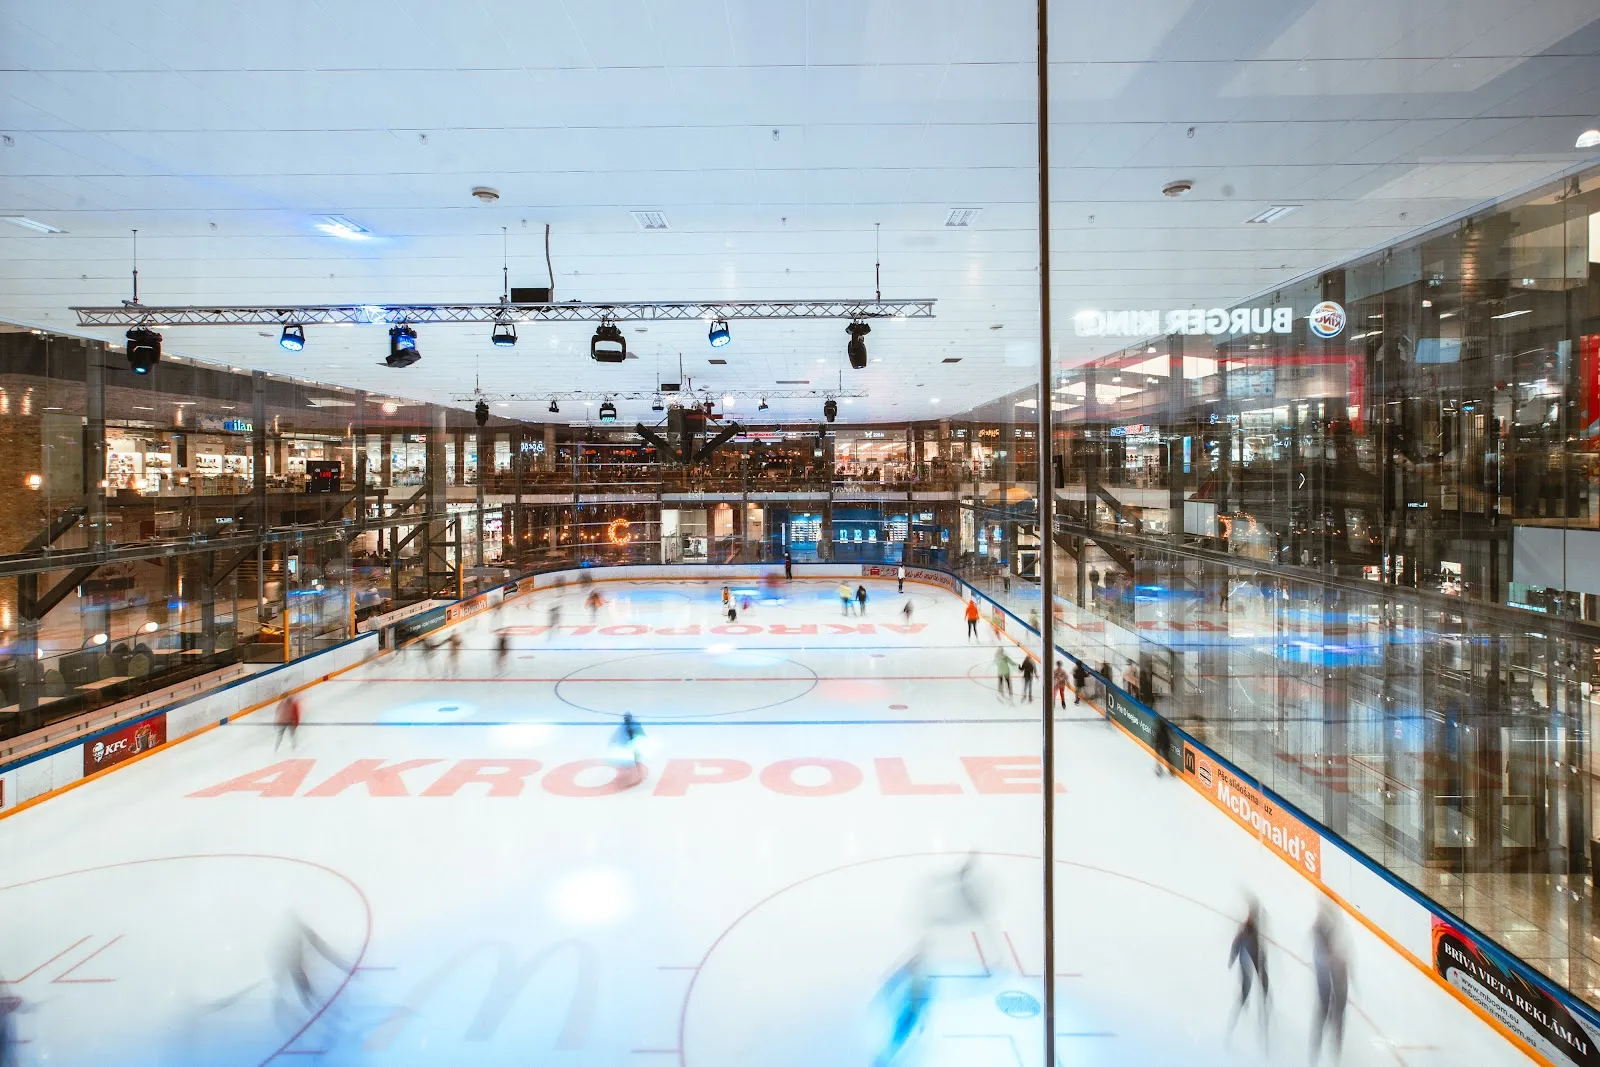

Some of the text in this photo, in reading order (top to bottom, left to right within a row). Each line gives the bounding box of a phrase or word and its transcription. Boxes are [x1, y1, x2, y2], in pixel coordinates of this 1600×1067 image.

[494, 622, 930, 637] AKROPOLE
[104, 738, 128, 756] KFC
[184, 755, 1068, 798] AKROPOLE
[1217, 769, 1229, 784] Pēc
[1264, 804, 1273, 816] uz
[1217, 780, 1317, 873] McDonald's
[1444, 942, 1588, 1056] BRĪVA VIETA REKLĀMAI
